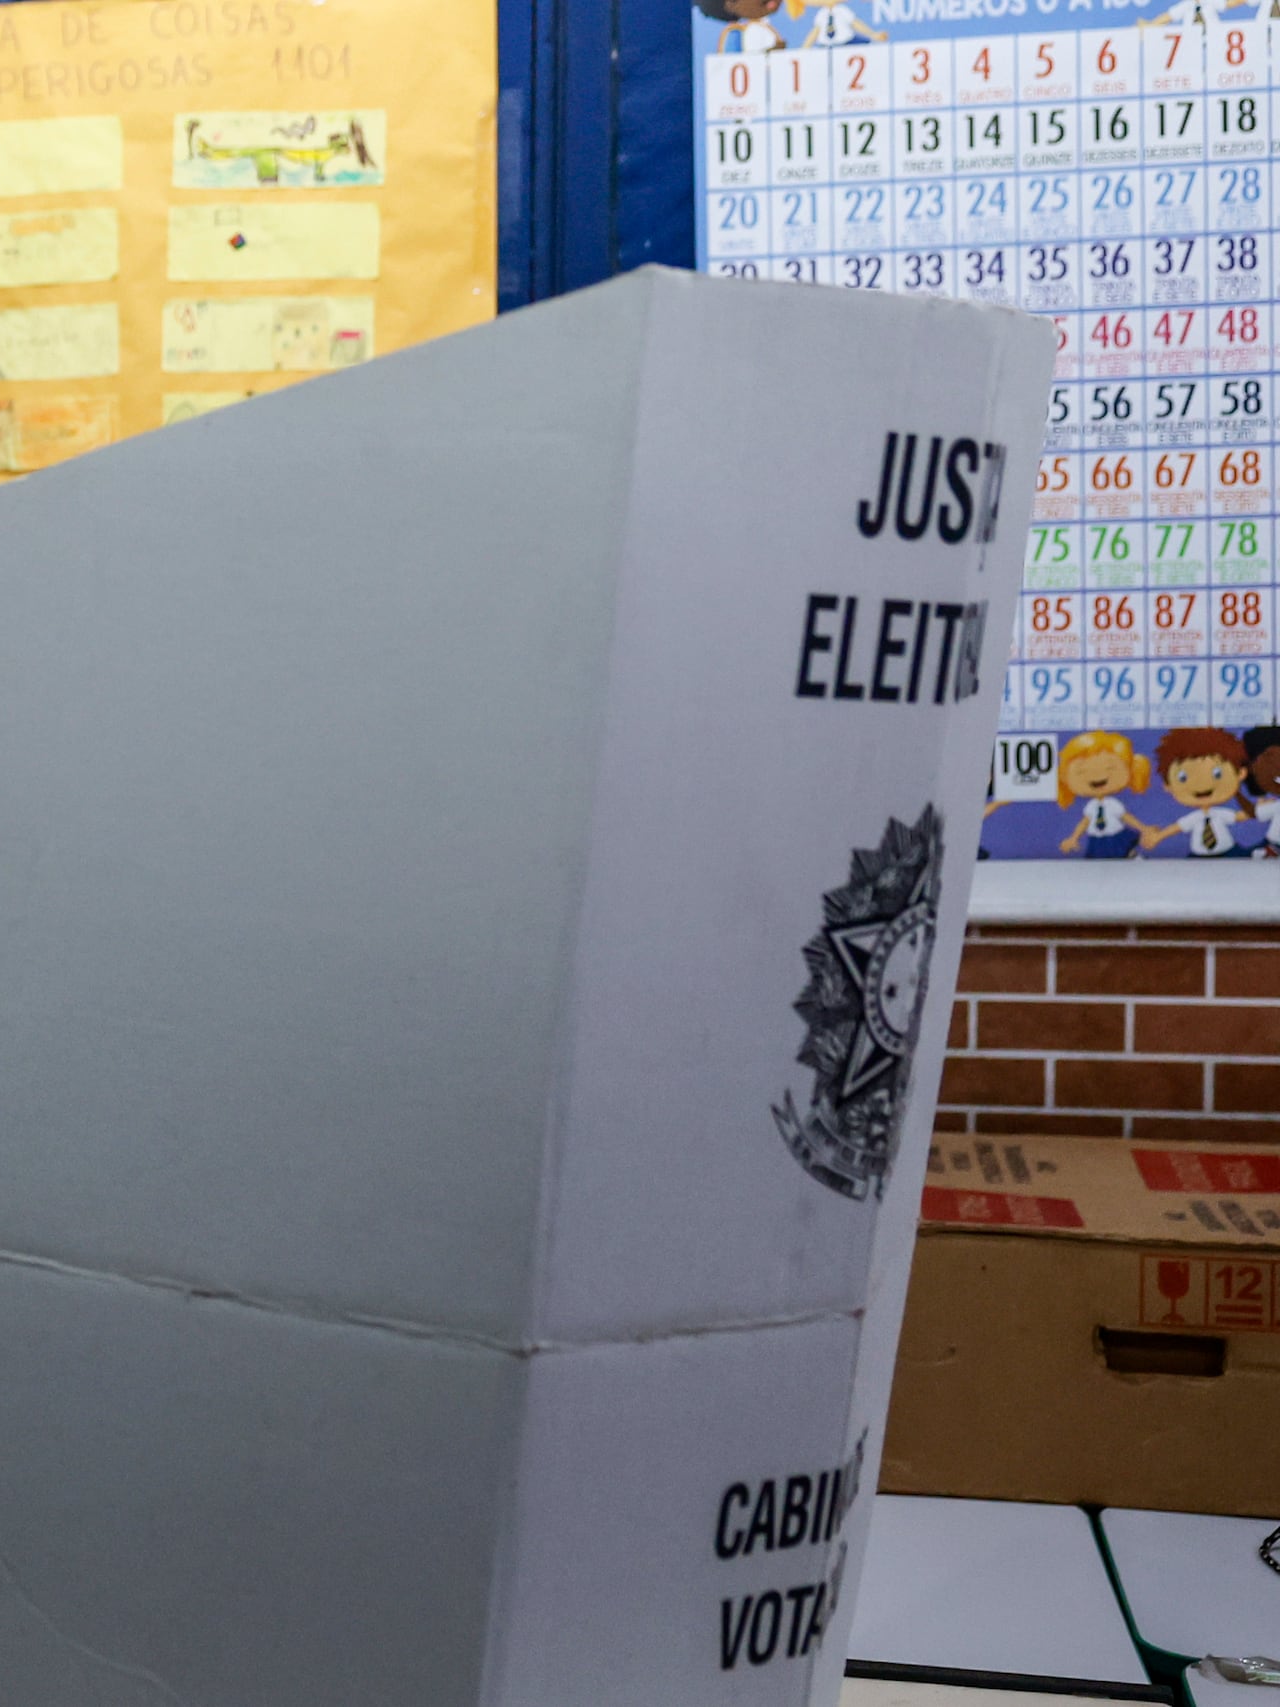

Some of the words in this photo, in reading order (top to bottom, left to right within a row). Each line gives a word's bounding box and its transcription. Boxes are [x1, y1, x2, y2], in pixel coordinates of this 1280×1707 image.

[61, 8, 111, 49] DE
[150, 1, 296, 41] COISAS
[730, 63, 749, 98] 0
[791, 59, 800, 93] 1
[847, 55, 866, 91] 2
[911, 49, 930, 84] 3
[972, 47, 991, 81] 4
[1035, 42, 1055, 79] 5
[1097, 38, 1117, 74] 6
[1163, 34, 1182, 70] 7
[1225, 30, 1245, 66] 8
[718, 128, 753, 164] 10
[784, 124, 814, 160] 11
[841, 121, 877, 156] 12
[904, 117, 940, 152] 13
[966, 113, 1002, 148] 14
[1030, 109, 1065, 145] 15
[1091, 106, 1130, 142] 16
[1156, 101, 1194, 137] 17
[1220, 98, 1257, 134] 18
[719, 194, 760, 230] 20
[783, 191, 818, 226] 21
[844, 187, 884, 223] 22
[904, 184, 945, 220] 23
[967, 181, 1007, 217] 24
[1028, 177, 1070, 213] 25
[1092, 174, 1133, 210] 26
[1155, 170, 1197, 206] 27
[1220, 167, 1261, 204] 28
[844, 256, 883, 289] 32
[904, 253, 944, 289] 33
[965, 249, 1005, 285] 34
[1028, 246, 1068, 282] 35
[1090, 243, 1130, 279] 36
[1154, 239, 1196, 275] 37
[1218, 236, 1258, 271] 38
[1091, 314, 1133, 349] 46
[1153, 311, 1195, 346] 47
[1217, 307, 1259, 343] 48
[1047, 388, 1069, 423] 5
[1091, 386, 1132, 421] 56
[1155, 383, 1196, 418] 57
[1221, 380, 1262, 416] 58
[1091, 455, 1132, 490] 66
[1155, 453, 1196, 488] 67
[1220, 450, 1261, 486] 68
[1031, 528, 1070, 562] 75
[1090, 526, 1130, 560] 76
[1154, 524, 1195, 559] 77
[1218, 521, 1258, 557] 78
[1032, 596, 1072, 632] 85
[1093, 595, 1134, 631] 86
[1155, 593, 1196, 630] 87
[1221, 592, 1262, 628] 88
[1031, 667, 1072, 703] 95
[1094, 666, 1136, 701] 96
[1157, 664, 1199, 700] 97
[1221, 663, 1262, 698] 98
[1000, 741, 1053, 775] 100
[1214, 1265, 1264, 1300] 12
